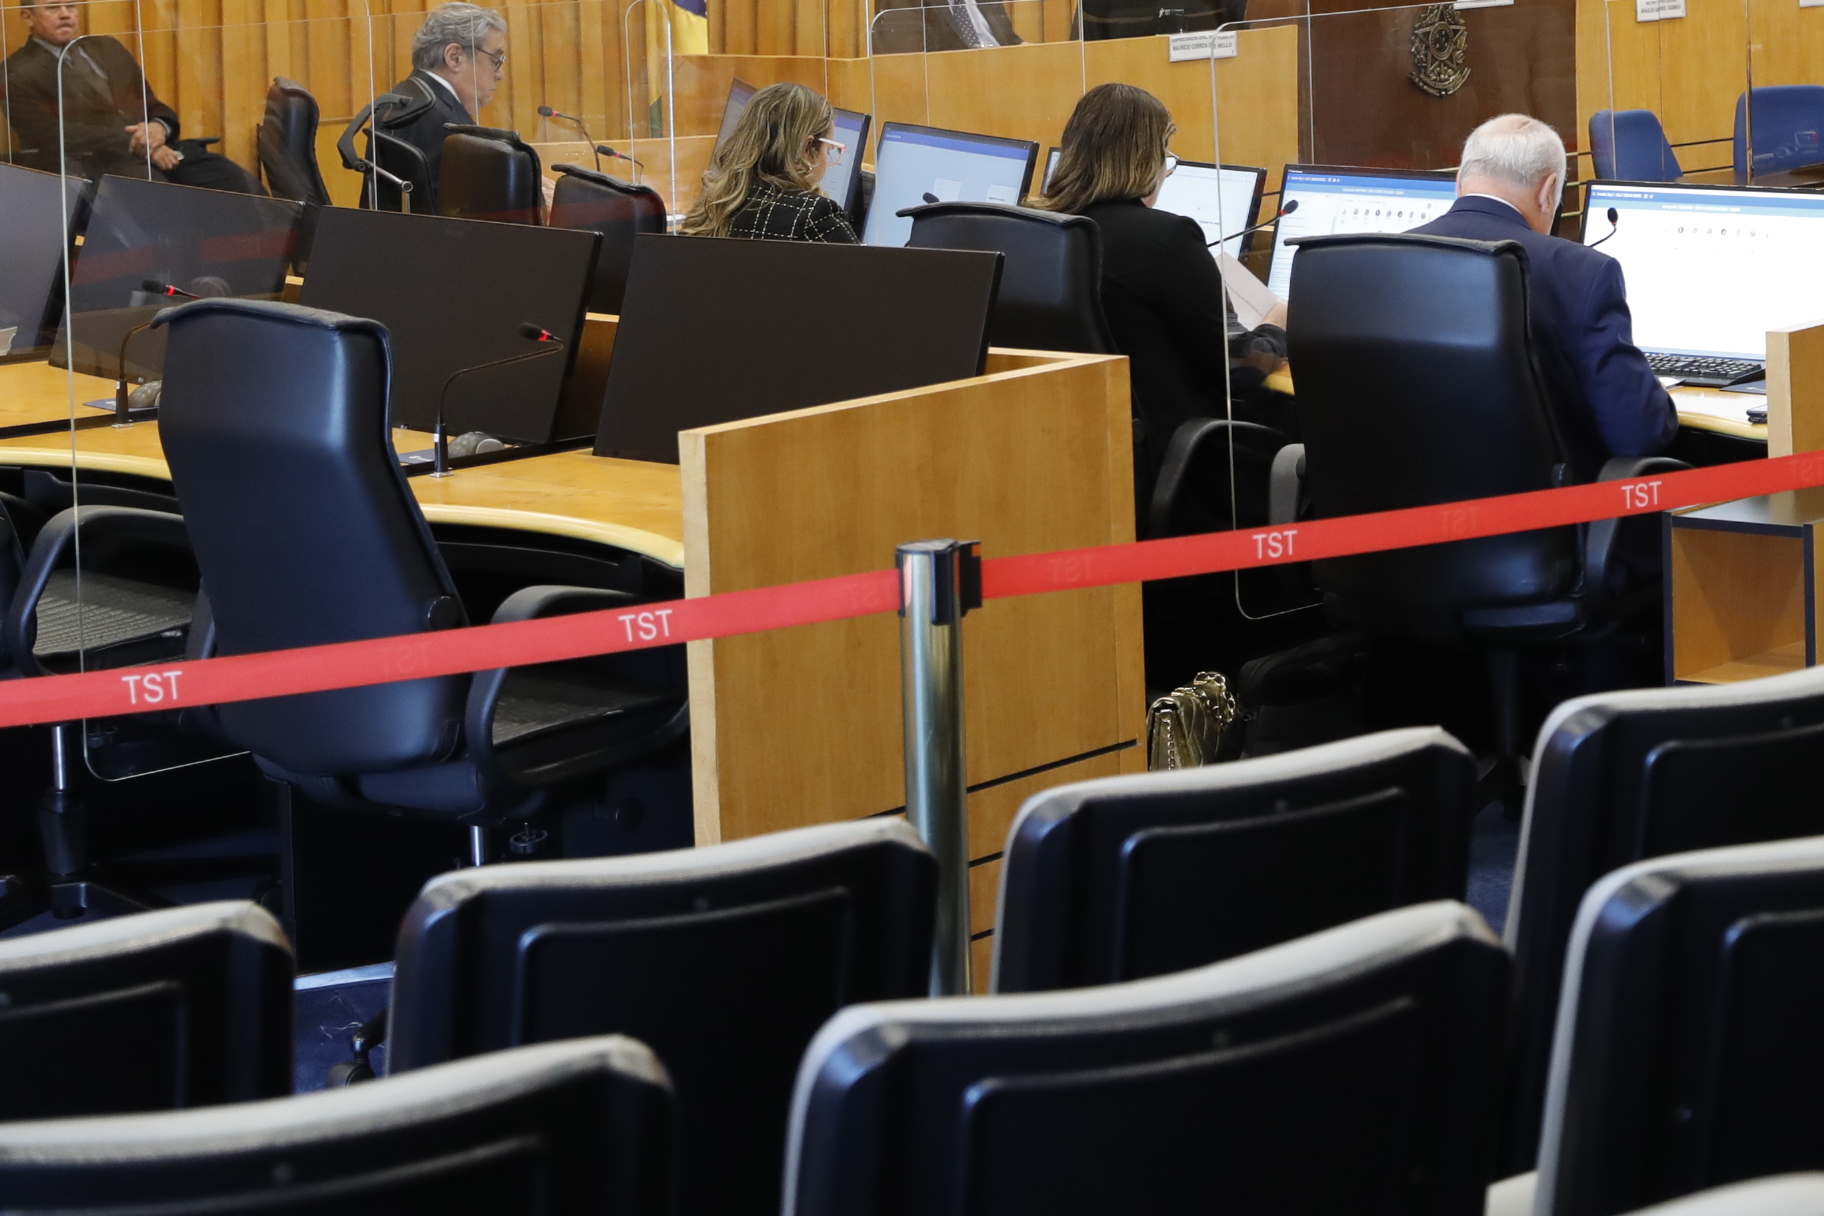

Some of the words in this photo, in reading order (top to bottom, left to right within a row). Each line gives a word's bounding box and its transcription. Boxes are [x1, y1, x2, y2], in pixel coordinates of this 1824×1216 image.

[1621, 481, 1663, 509] TST
[1252, 529, 1298, 560] TST
[618, 608, 673, 642] TST
[121, 670, 183, 705] TST
